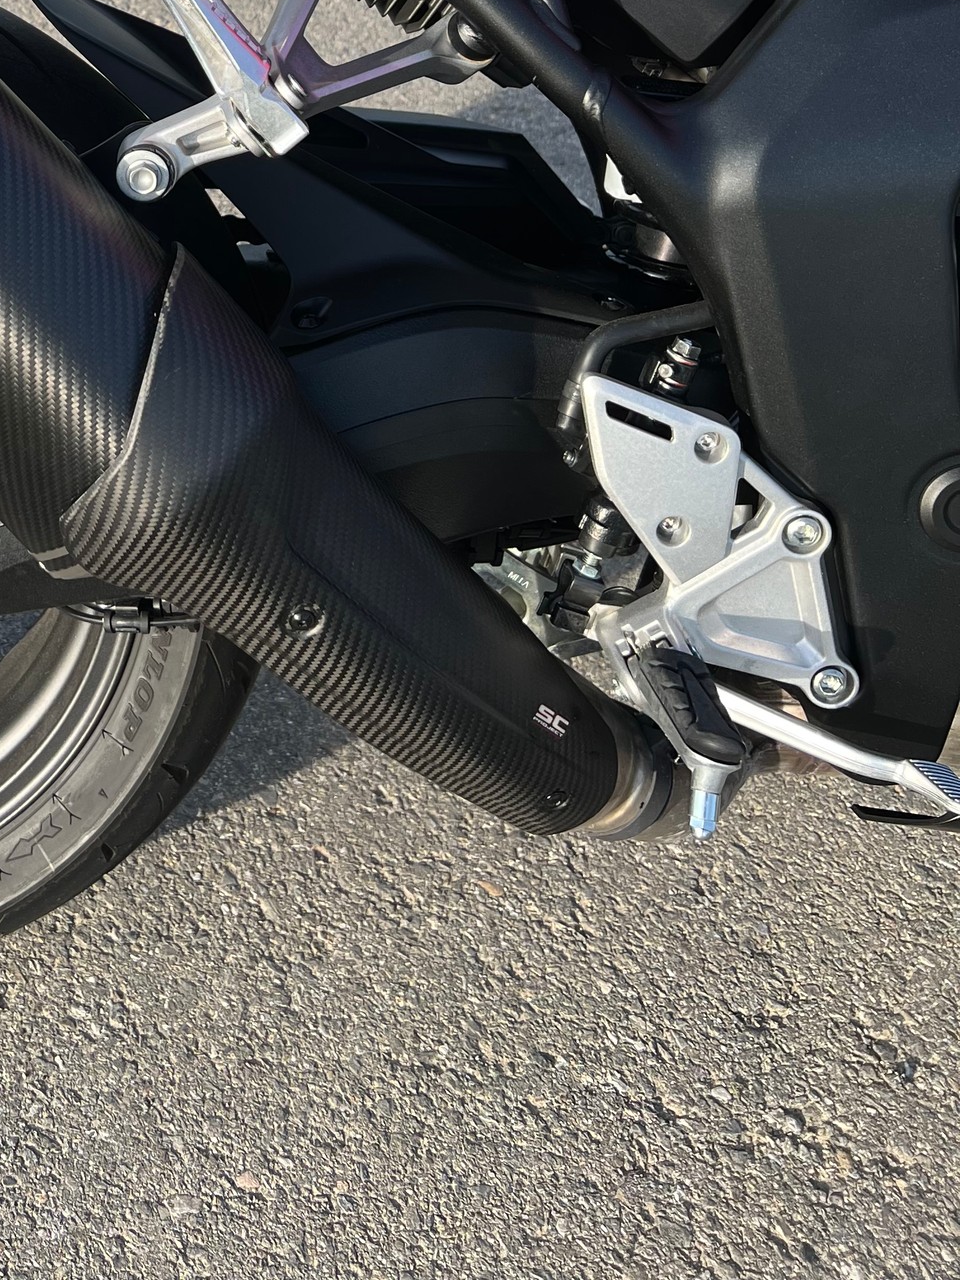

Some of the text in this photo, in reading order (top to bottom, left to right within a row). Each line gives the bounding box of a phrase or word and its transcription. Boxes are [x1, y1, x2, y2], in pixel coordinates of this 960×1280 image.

[123, 630, 172, 743] NLOP
[532, 716, 563, 738] PROJECT
[535, 704, 570, 734] SC
